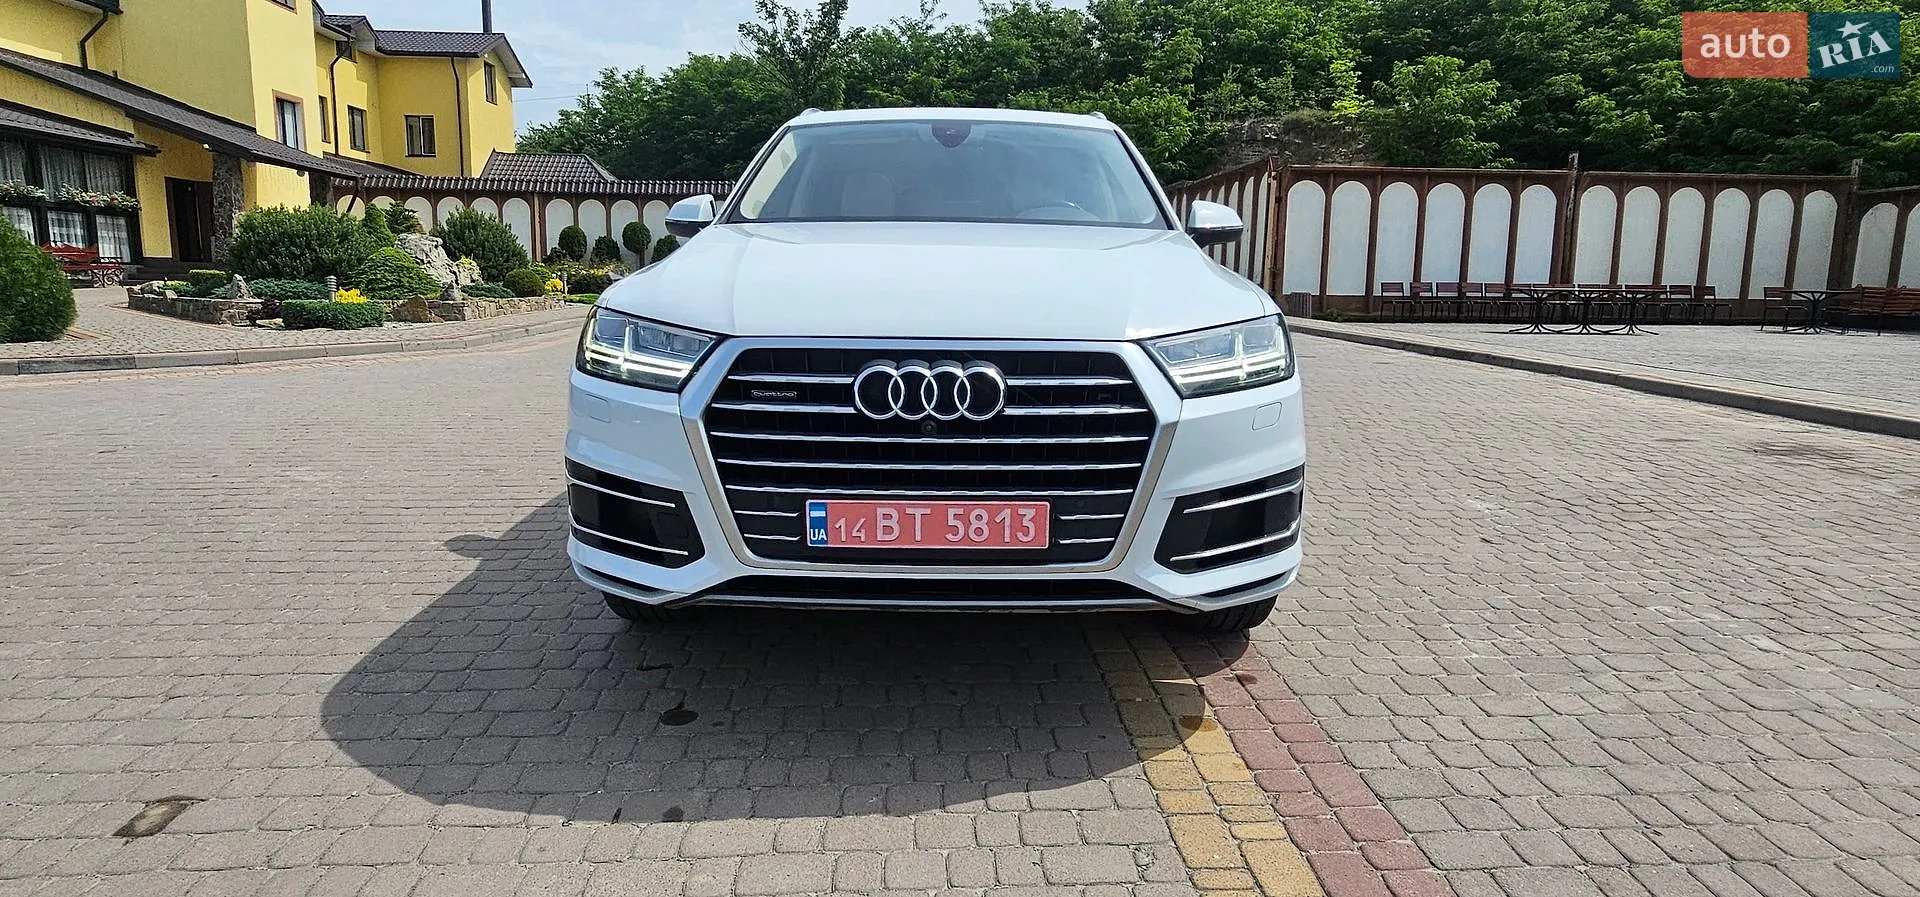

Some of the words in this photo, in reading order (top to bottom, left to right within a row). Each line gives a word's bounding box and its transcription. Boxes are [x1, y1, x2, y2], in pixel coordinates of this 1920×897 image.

[810, 528, 827, 541] UA
[834, 517, 867, 542] 14
[876, 507, 931, 542] BT
[945, 507, 1037, 543] 5813
